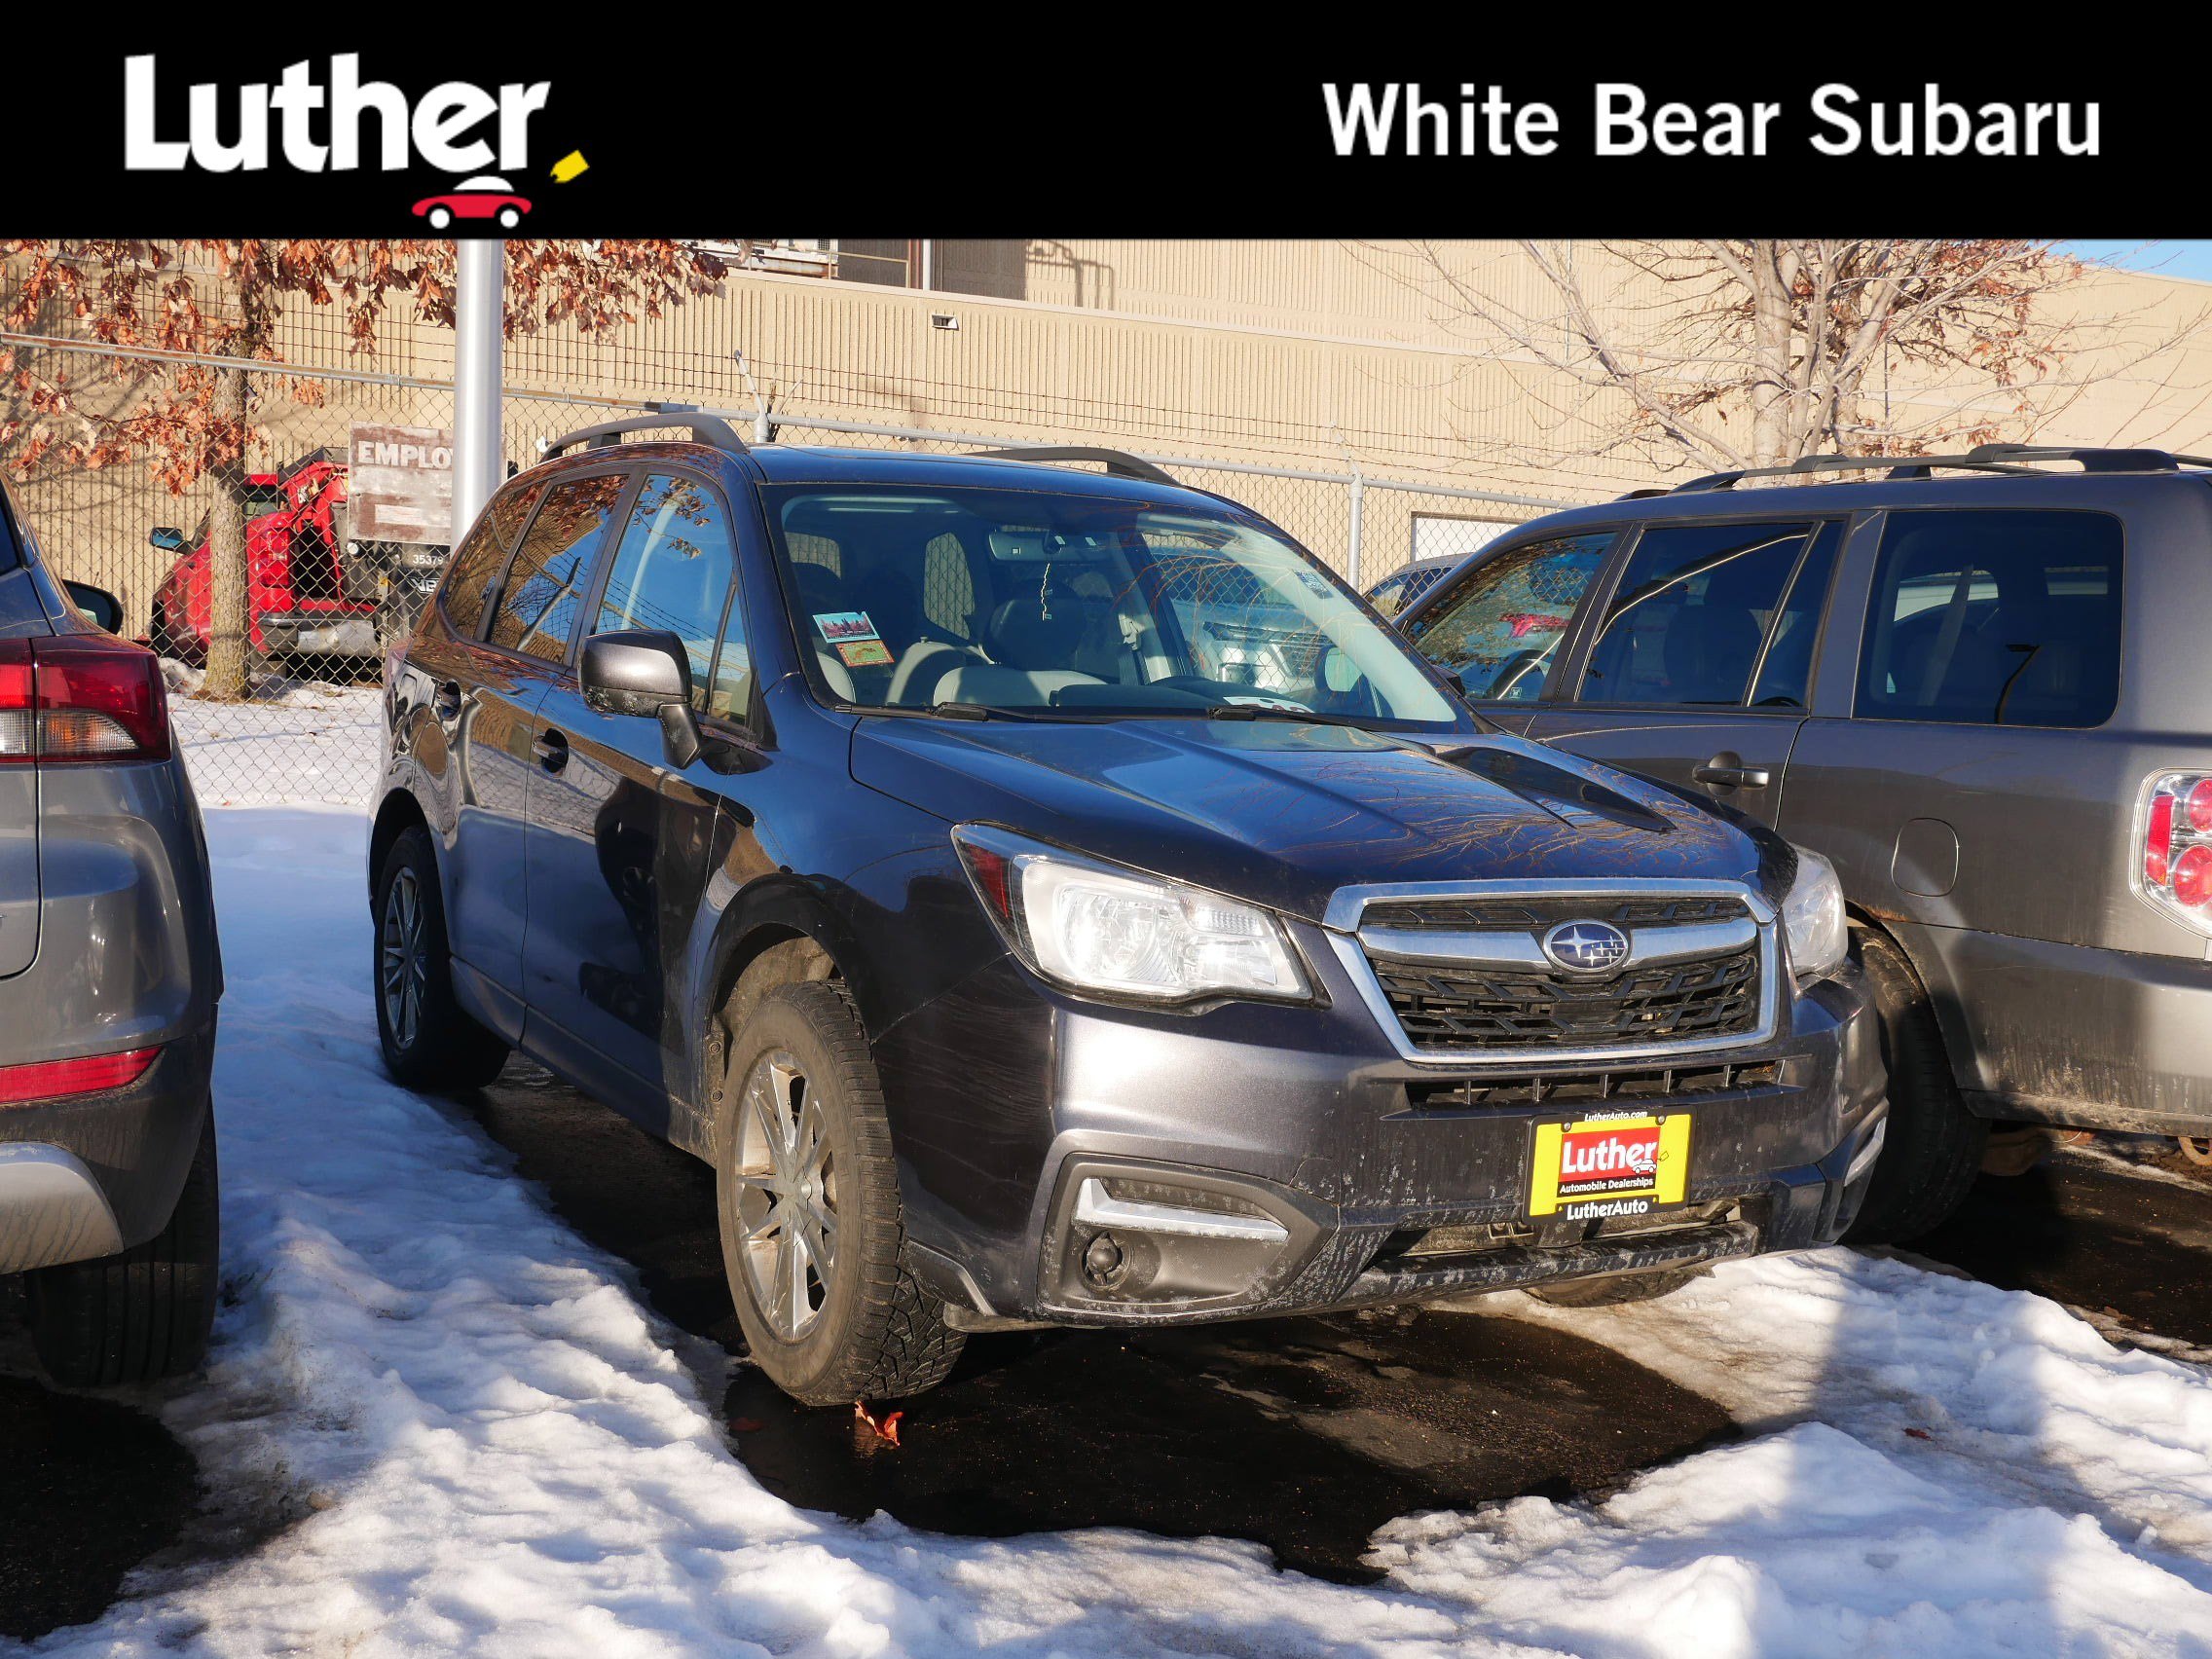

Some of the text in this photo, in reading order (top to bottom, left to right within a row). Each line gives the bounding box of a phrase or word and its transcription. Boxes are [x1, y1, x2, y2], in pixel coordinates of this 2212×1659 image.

[357, 441, 453, 469] EMPLO
[412, 554, 444, 565] 35379
[1584, 1111, 1648, 1123] LutherAuto.com
[1562, 1137, 1658, 1174] Luther
[1560, 1177, 1653, 1194] Automobile Dealerships
[1567, 1199, 1648, 1221] LutherAuto
